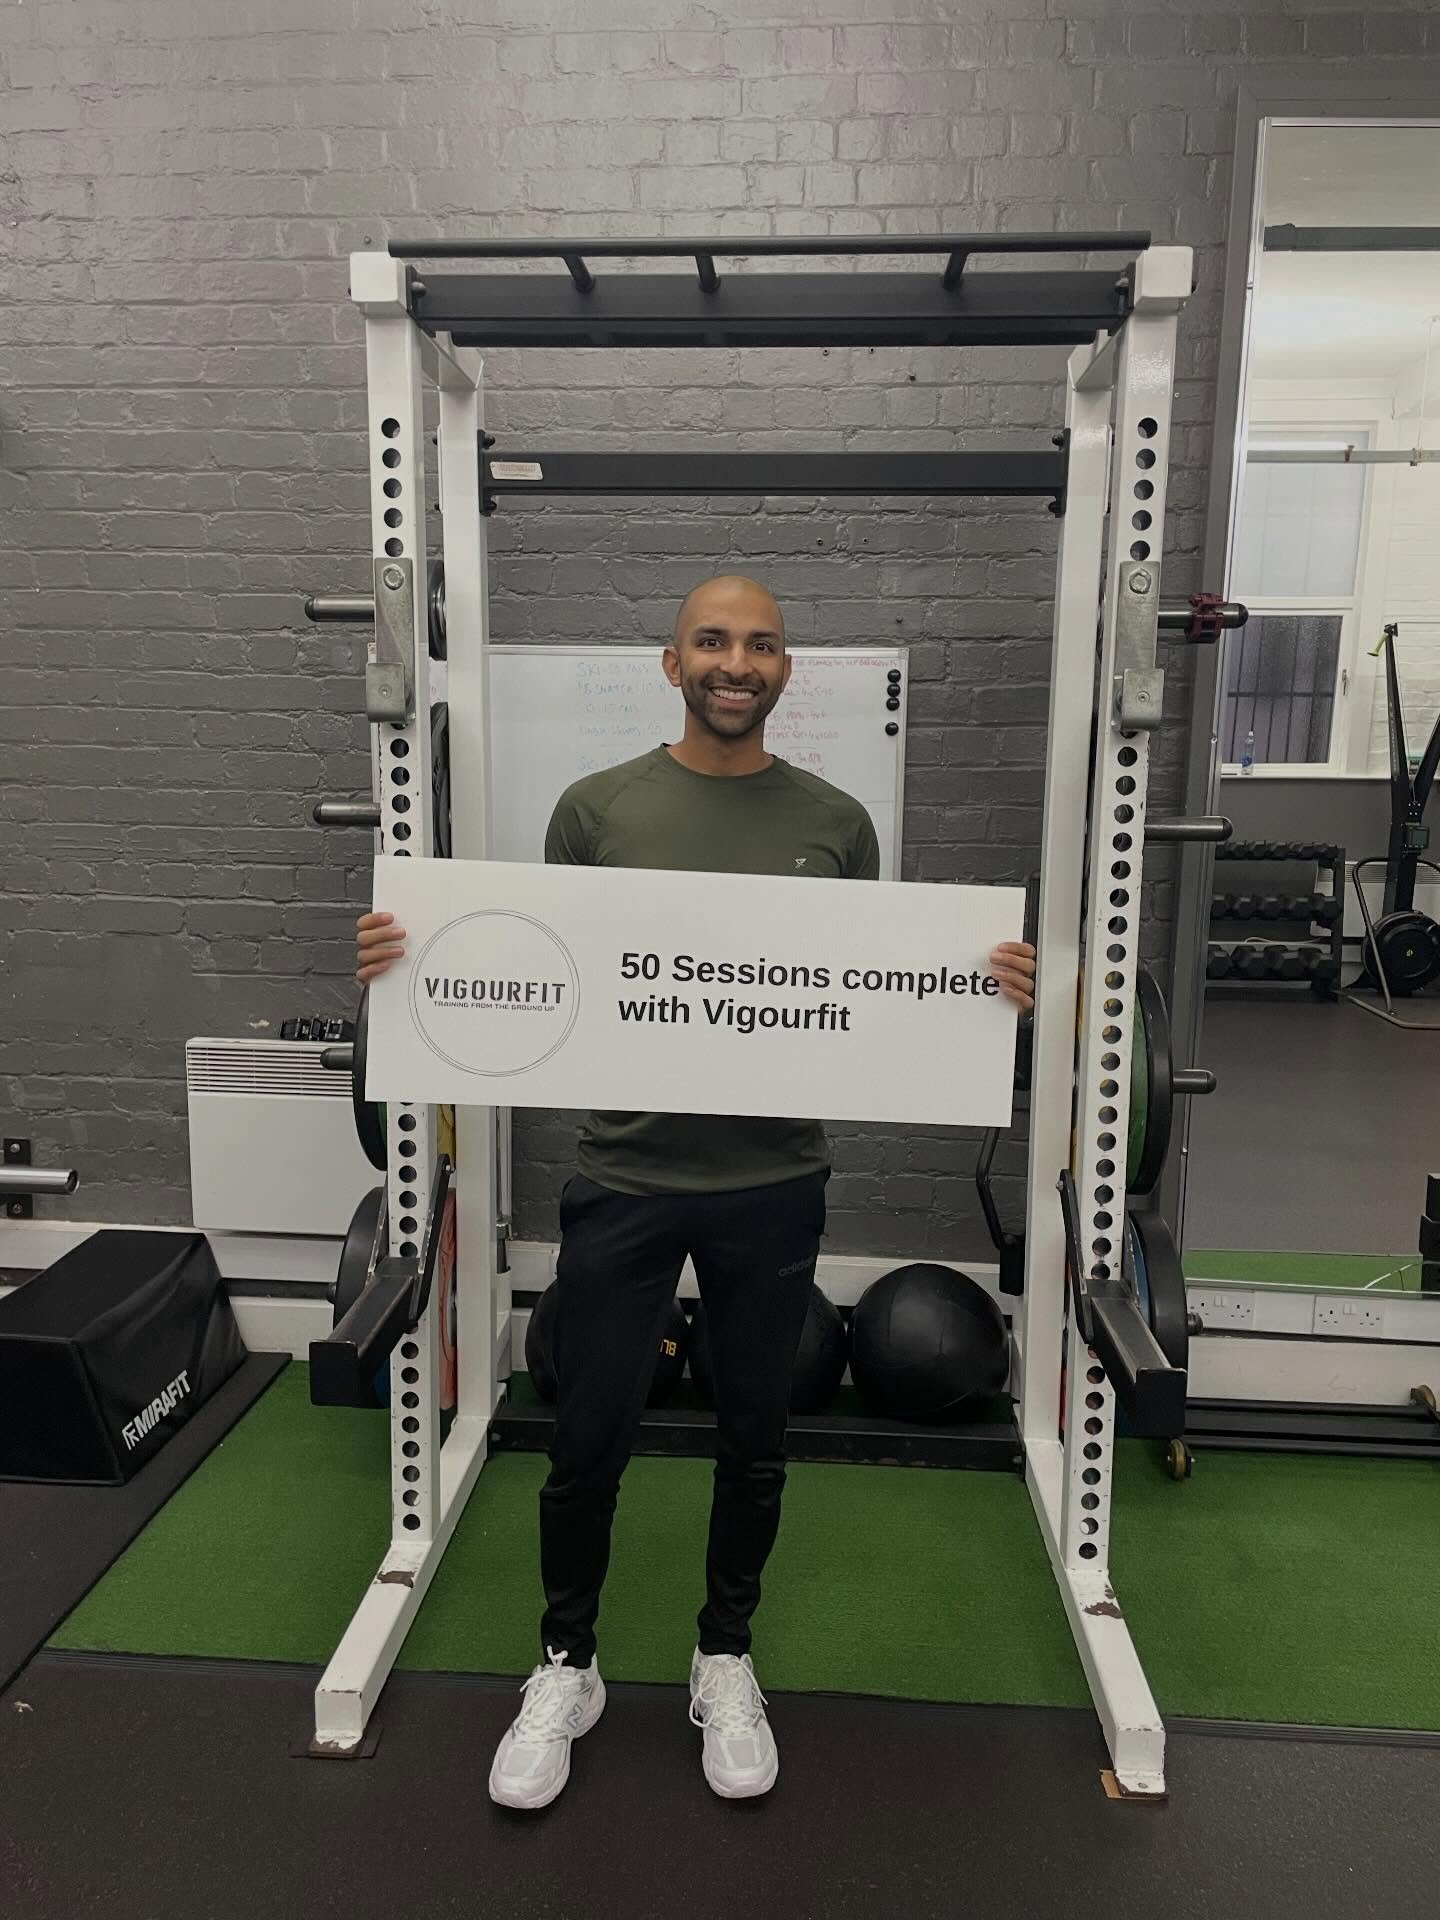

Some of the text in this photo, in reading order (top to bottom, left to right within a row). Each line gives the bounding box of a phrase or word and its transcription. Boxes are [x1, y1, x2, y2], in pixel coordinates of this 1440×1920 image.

[424, 977, 566, 1004] VIGOURFIT
[621, 953, 1001, 1001] 50 Sessions complete
[433, 1000, 470, 1009] TRAINING
[471, 1002, 494, 1010] FROM
[511, 1004, 543, 1012] GROUND
[618, 995, 851, 1034] with Vigourfit
[133, 1369, 191, 1439] MIRAFIT
